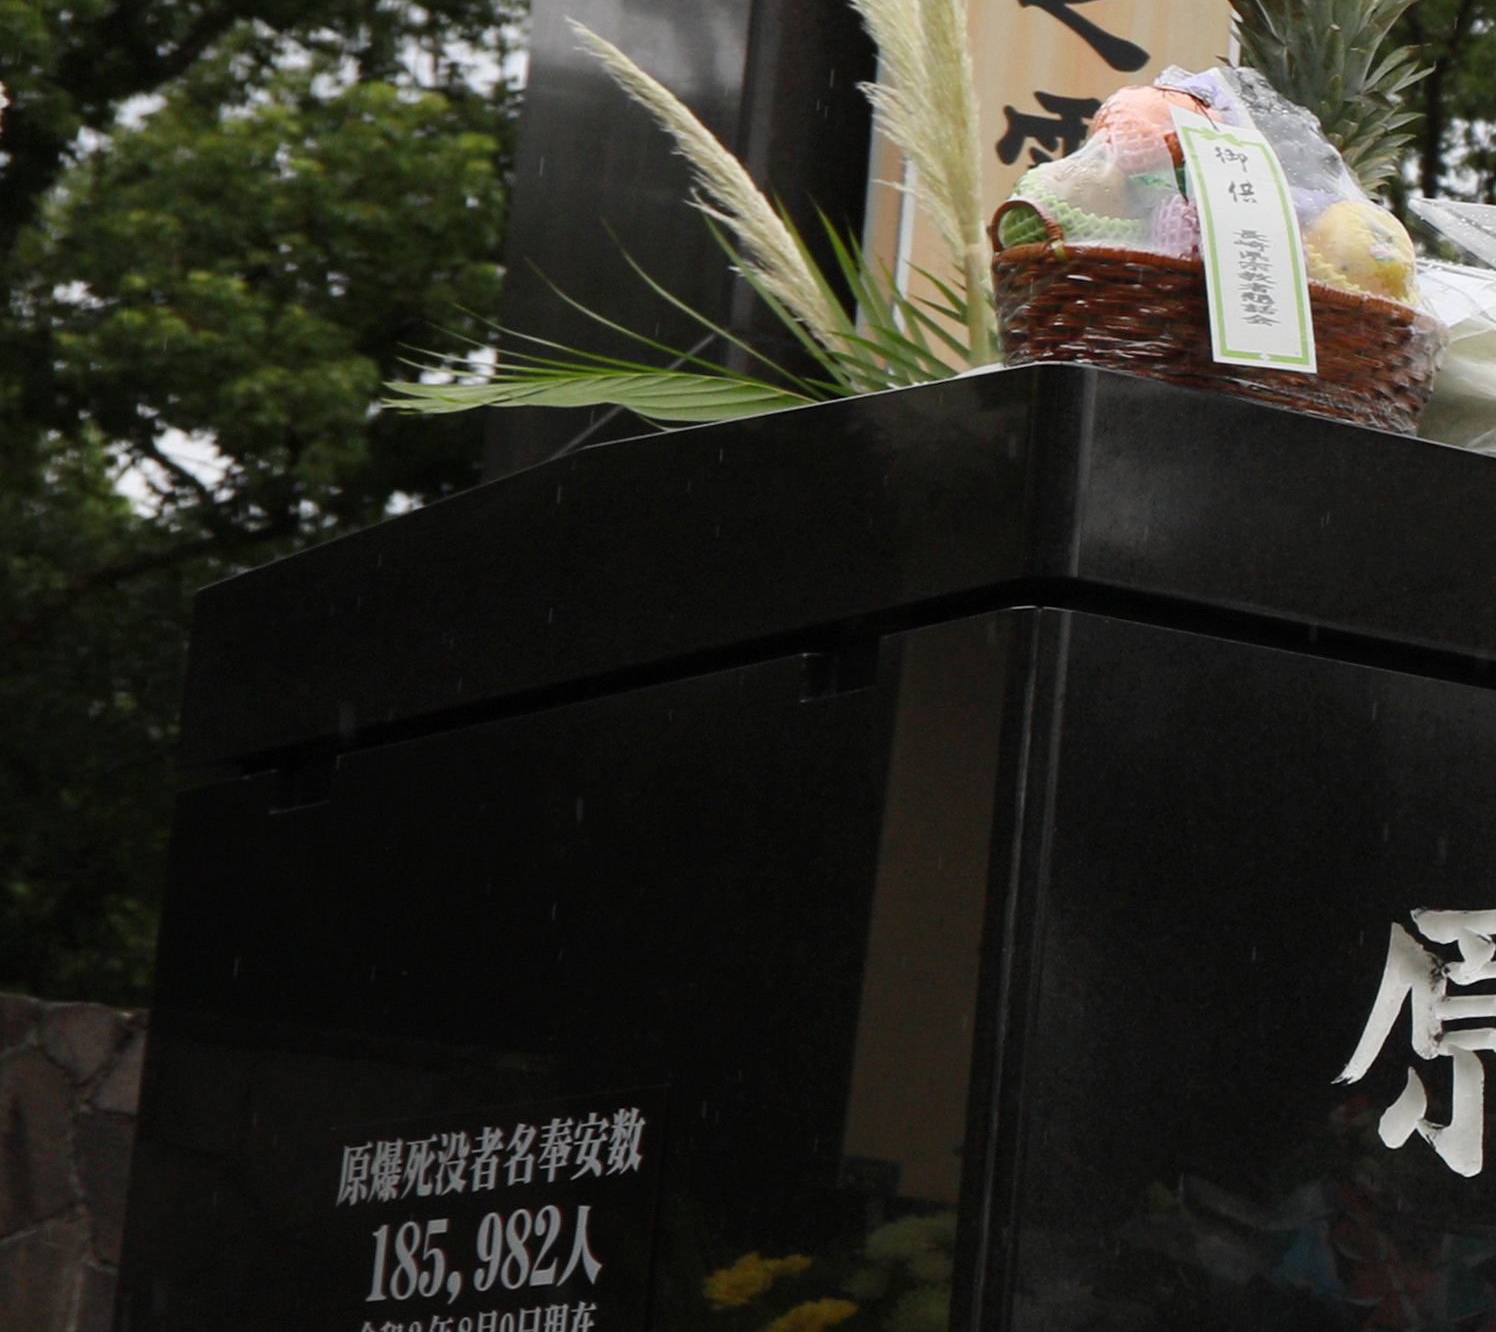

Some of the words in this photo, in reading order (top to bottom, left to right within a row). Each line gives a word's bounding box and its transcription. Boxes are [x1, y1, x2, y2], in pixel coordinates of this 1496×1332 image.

[335, 1107, 646, 1207] 原爆死没者名奉安数
[364, 1204, 603, 1304] 185,982人
